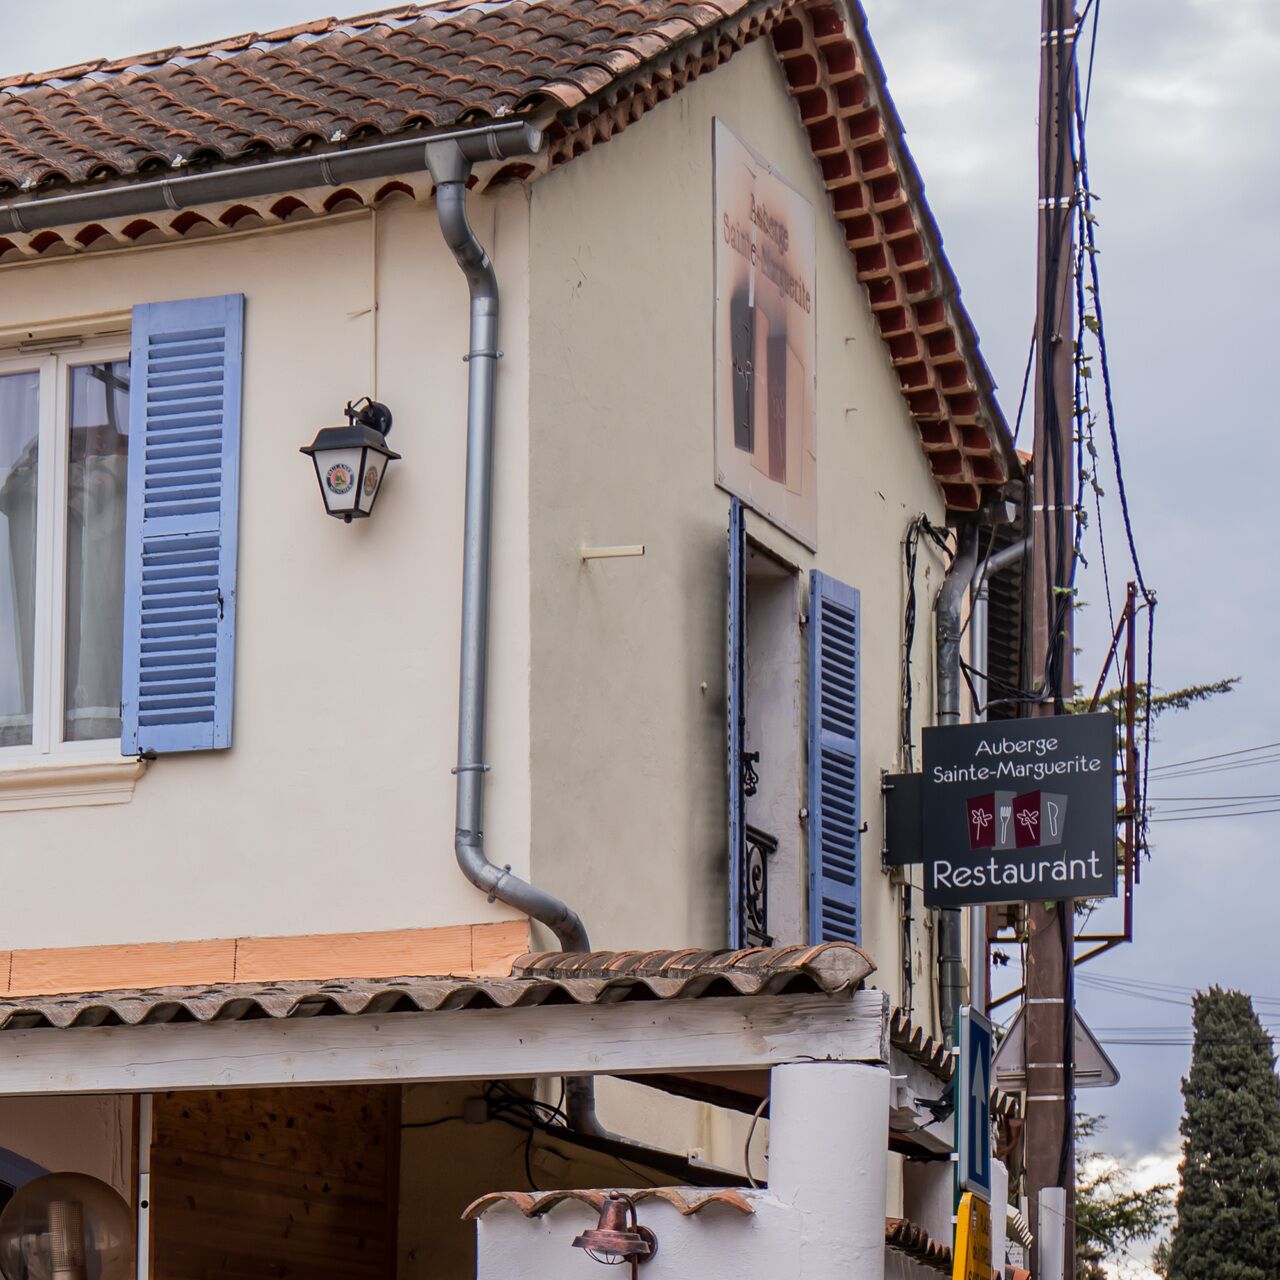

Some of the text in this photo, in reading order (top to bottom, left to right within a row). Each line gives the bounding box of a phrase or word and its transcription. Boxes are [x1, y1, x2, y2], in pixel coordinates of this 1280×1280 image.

[975, 738, 1058, 756] Auberge
[934, 755, 1101, 783] Sainte-Marguerite
[934, 850, 1103, 888] Restaurant
